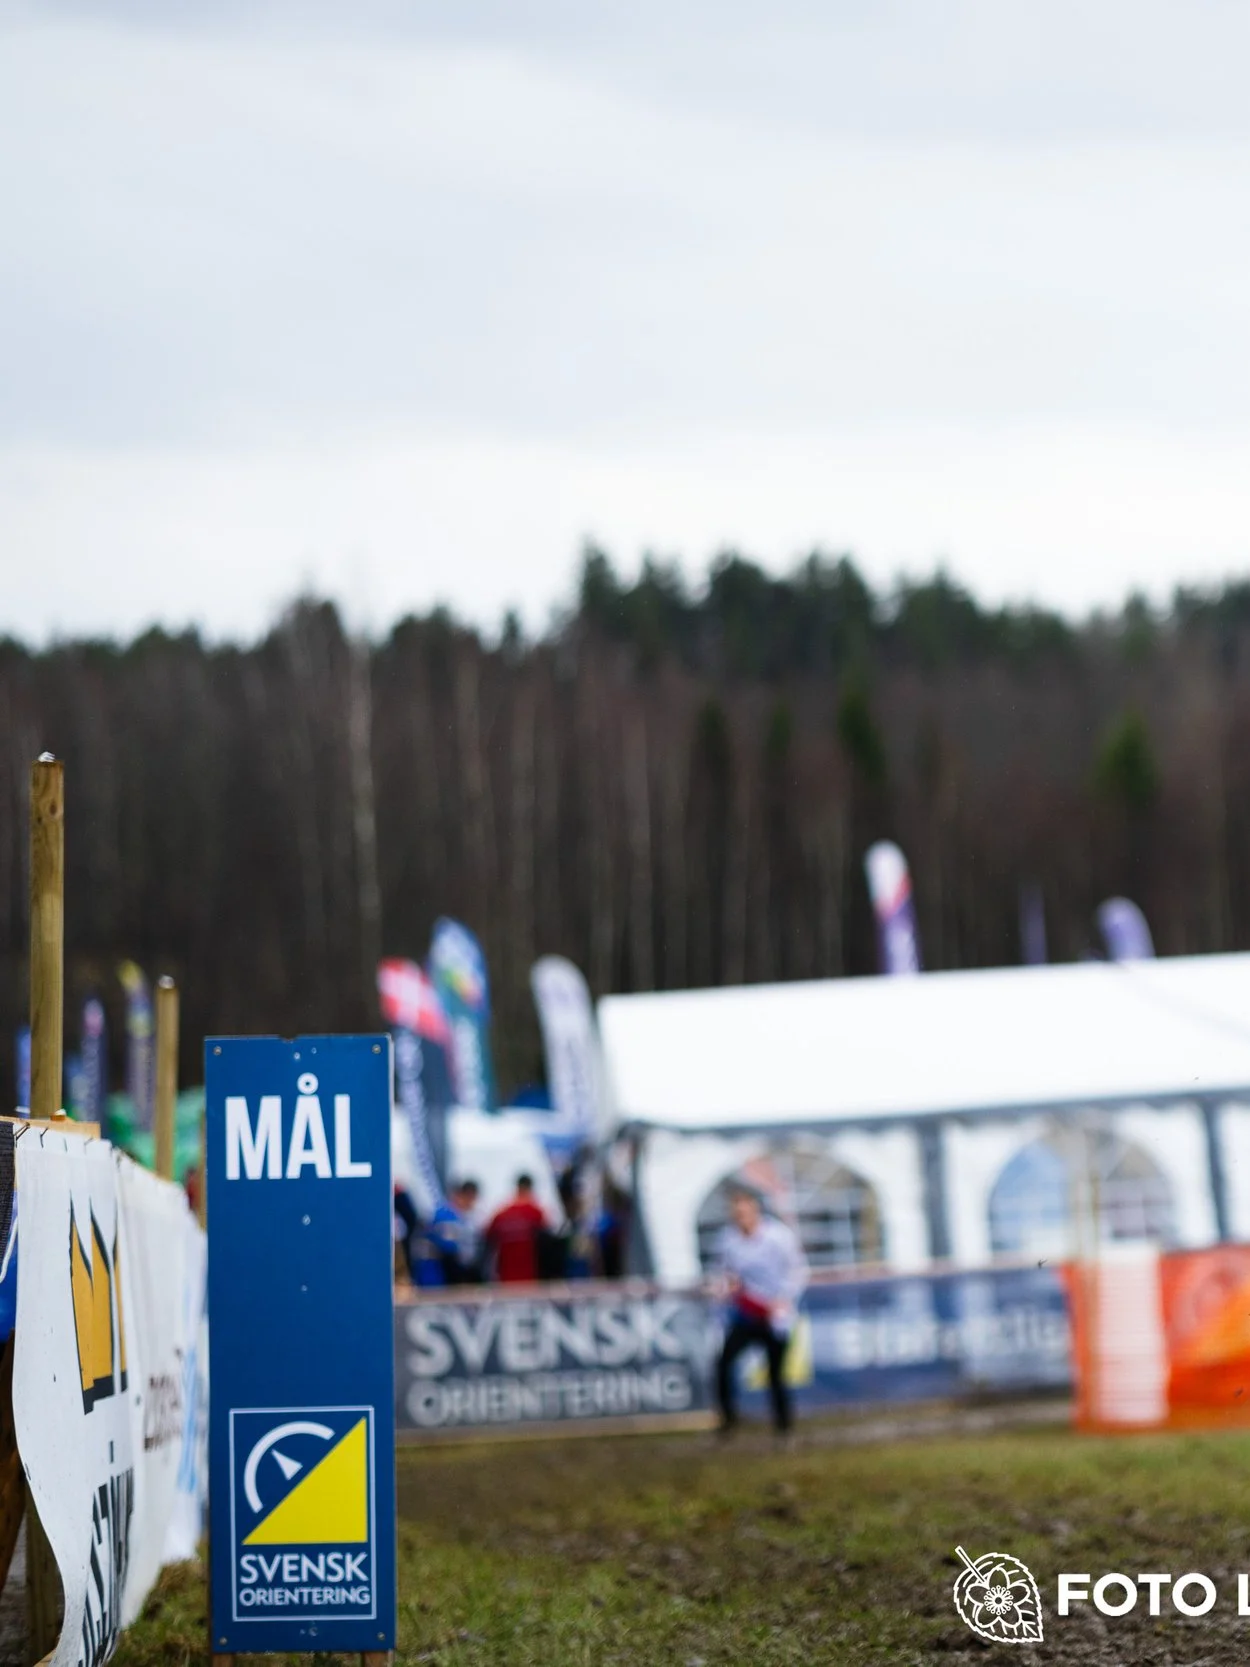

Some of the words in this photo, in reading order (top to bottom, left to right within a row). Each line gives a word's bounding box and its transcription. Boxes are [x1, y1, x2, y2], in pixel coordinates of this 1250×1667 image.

[225, 1072, 372, 1181] MÅL
[405, 1297, 686, 1377] SVENSK
[405, 1362, 693, 1427] ORIENTERING
[239, 1585, 371, 1607] ORIENTERING
[240, 1552, 369, 1585] SVENSK
